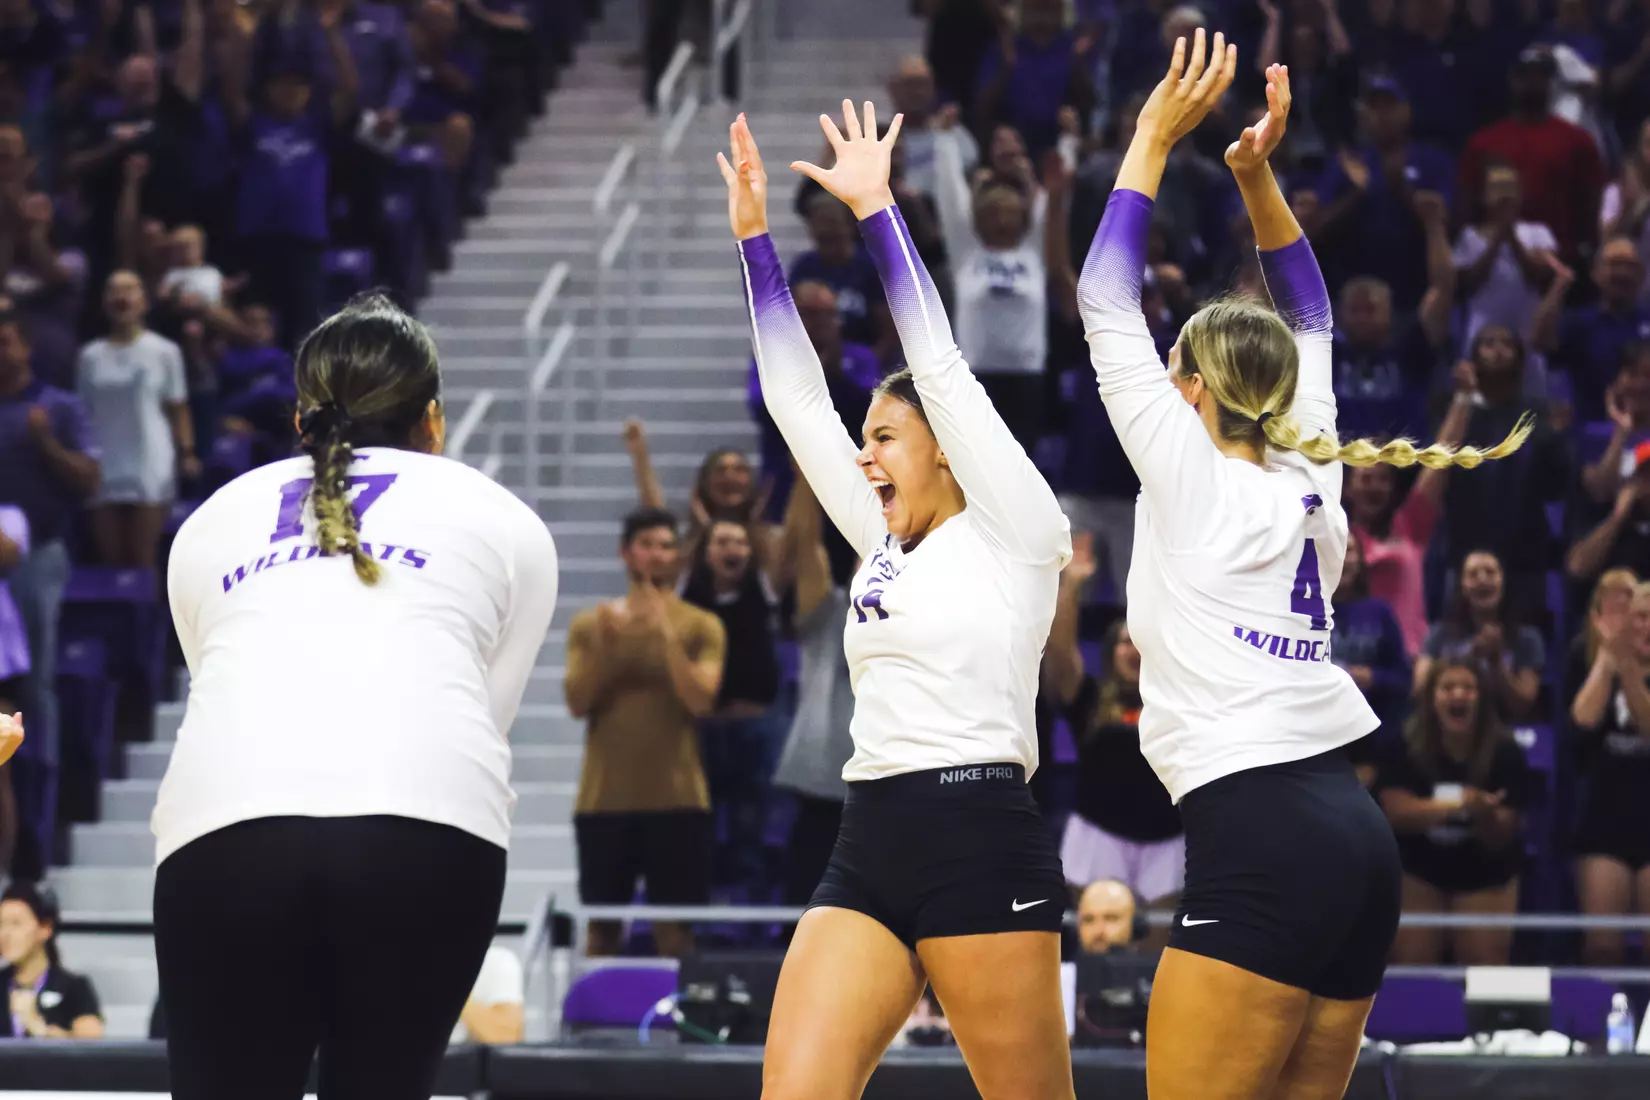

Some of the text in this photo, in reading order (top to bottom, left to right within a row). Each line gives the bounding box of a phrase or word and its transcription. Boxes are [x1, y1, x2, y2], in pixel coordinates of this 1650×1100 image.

[270, 473, 398, 544] 17
[222, 542, 431, 594] WILDATS
[1290, 538, 1328, 631] 4
[940, 767, 1013, 785] NIKE PRO
